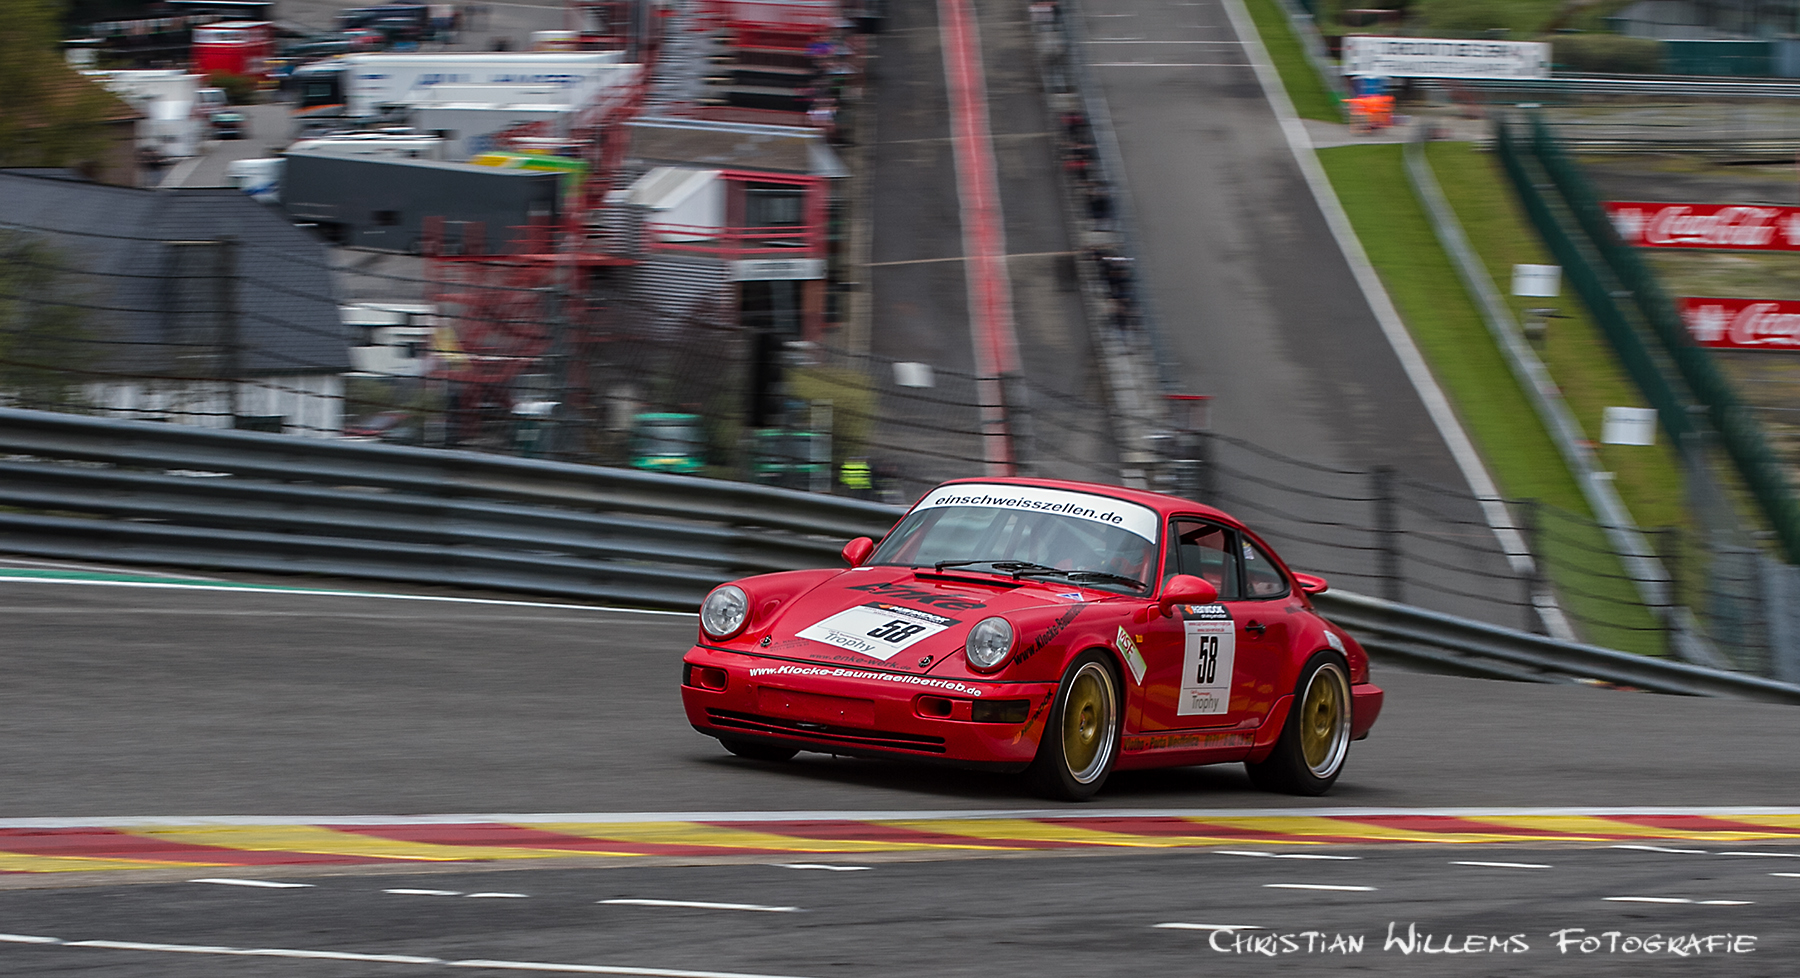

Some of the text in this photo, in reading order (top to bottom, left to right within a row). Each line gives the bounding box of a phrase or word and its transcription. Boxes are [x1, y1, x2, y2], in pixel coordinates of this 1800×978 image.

[935, 495, 1123, 524] einschweisszellen.de
[824, 632, 876, 653] Trophy
[867, 619, 926, 643] 58
[809, 653, 912, 671] www.enke-werk.de
[1197, 636, 1218, 684] 58
[750, 665, 982, 697] www.Klocke-Baumfaellbetrieb.de
[1191, 694, 1220, 712] Trophy
